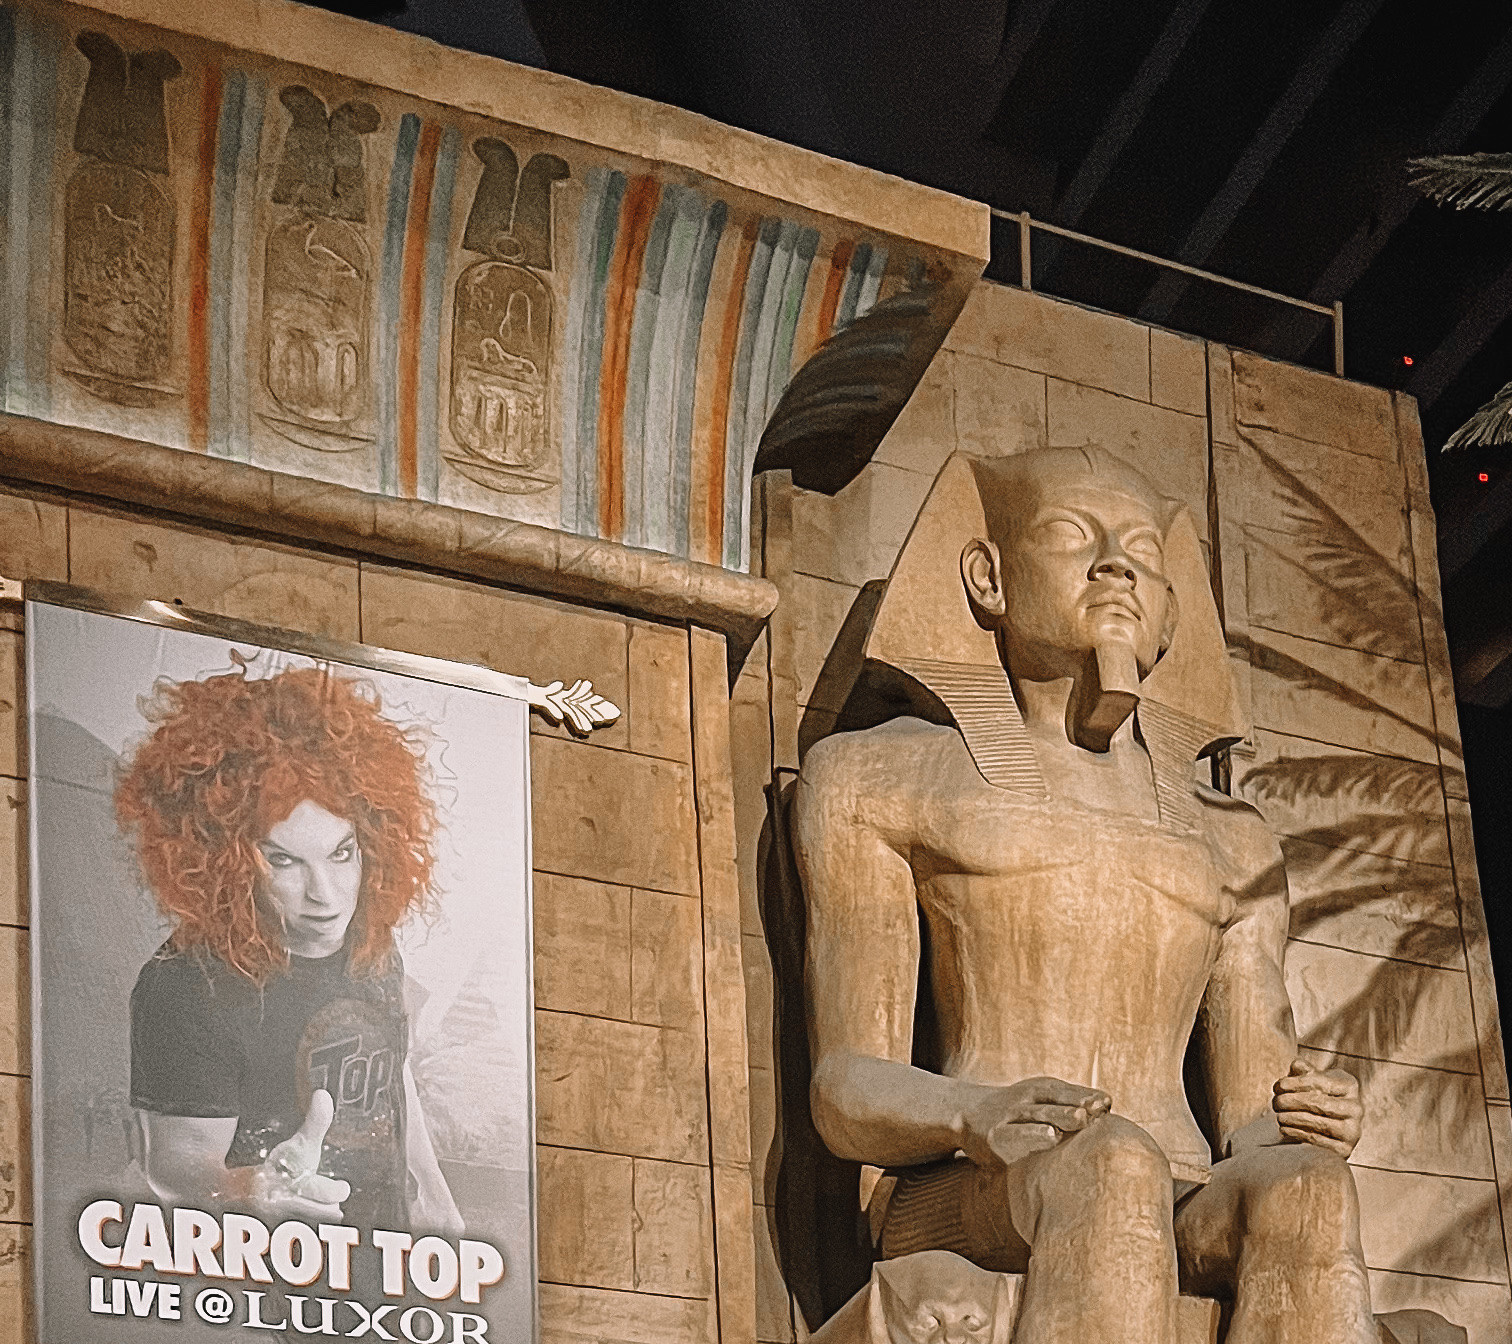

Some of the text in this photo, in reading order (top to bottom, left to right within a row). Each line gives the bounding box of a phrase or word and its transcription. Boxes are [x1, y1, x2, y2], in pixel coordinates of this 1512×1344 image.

[78, 1200, 505, 1303] CARROT TOP
[90, 1276, 181, 1320] LIVE
